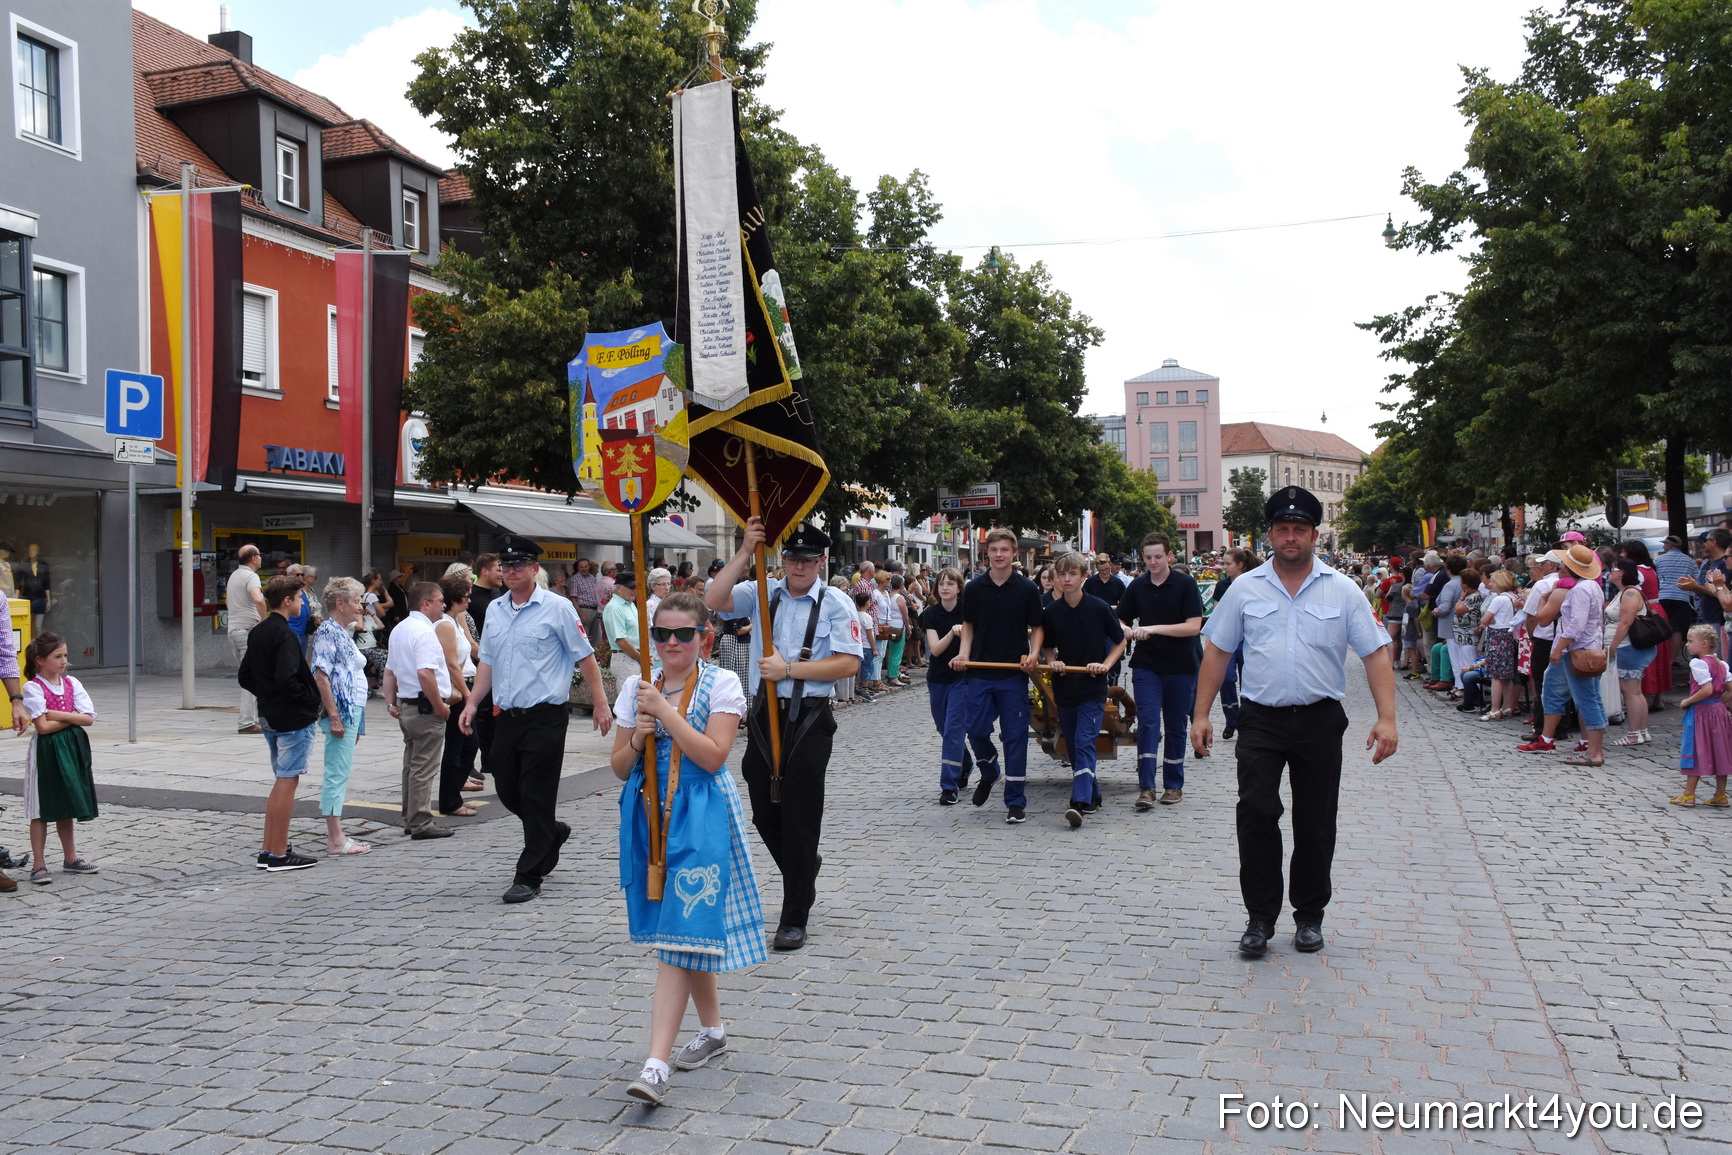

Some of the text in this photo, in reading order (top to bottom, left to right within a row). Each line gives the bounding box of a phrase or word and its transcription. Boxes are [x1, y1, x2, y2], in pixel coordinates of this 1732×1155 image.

[617, 344, 651, 361] Pölling
[119, 379, 150, 428] P
[265, 518, 281, 527] NZ
